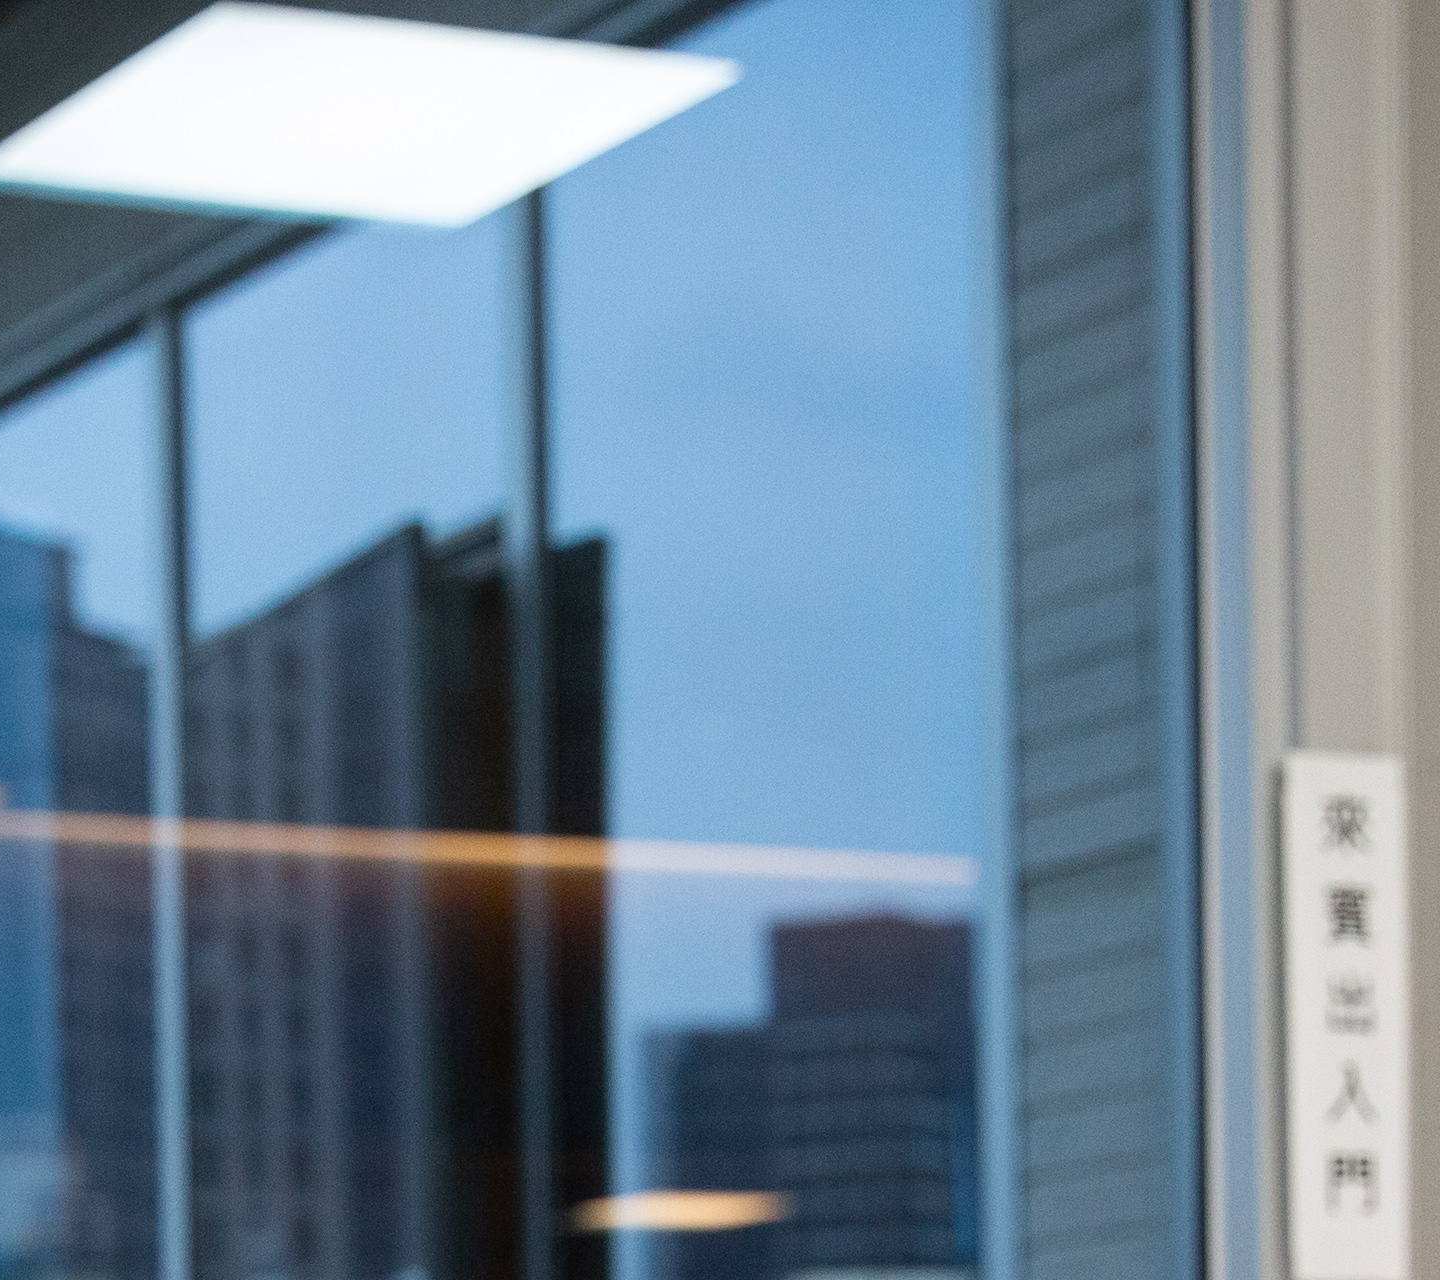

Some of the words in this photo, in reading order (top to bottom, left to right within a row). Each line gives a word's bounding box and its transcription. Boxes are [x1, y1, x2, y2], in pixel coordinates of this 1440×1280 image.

[1323, 796, 1379, 1214] 來賓出入門
